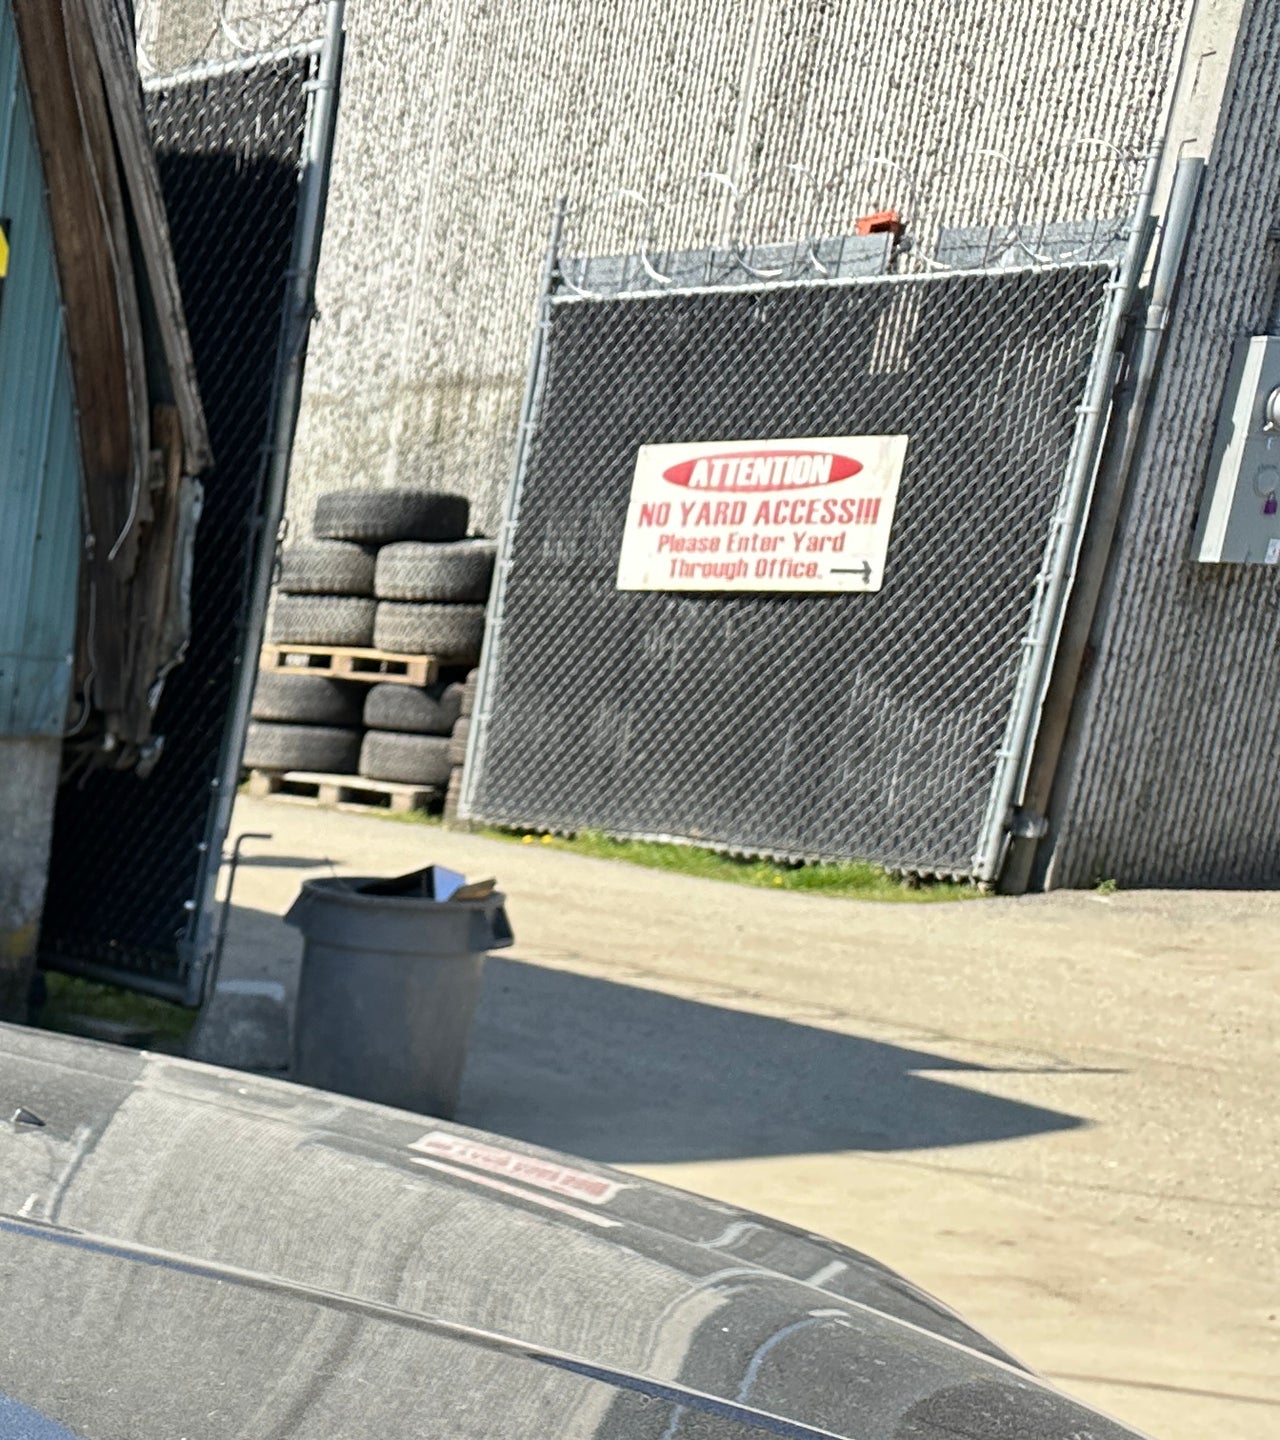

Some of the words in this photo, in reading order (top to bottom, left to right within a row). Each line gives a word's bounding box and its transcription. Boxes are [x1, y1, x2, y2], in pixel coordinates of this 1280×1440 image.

[688, 455, 834, 488] ATTENTION
[638, 502, 672, 528] NO
[680, 500, 748, 528] YARD
[753, 497, 883, 526] ACCESS!!!
[657, 533, 720, 553] Please
[727, 533, 785, 553] Enter
[793, 531, 847, 553] Yard
[669, 558, 749, 582] Through
